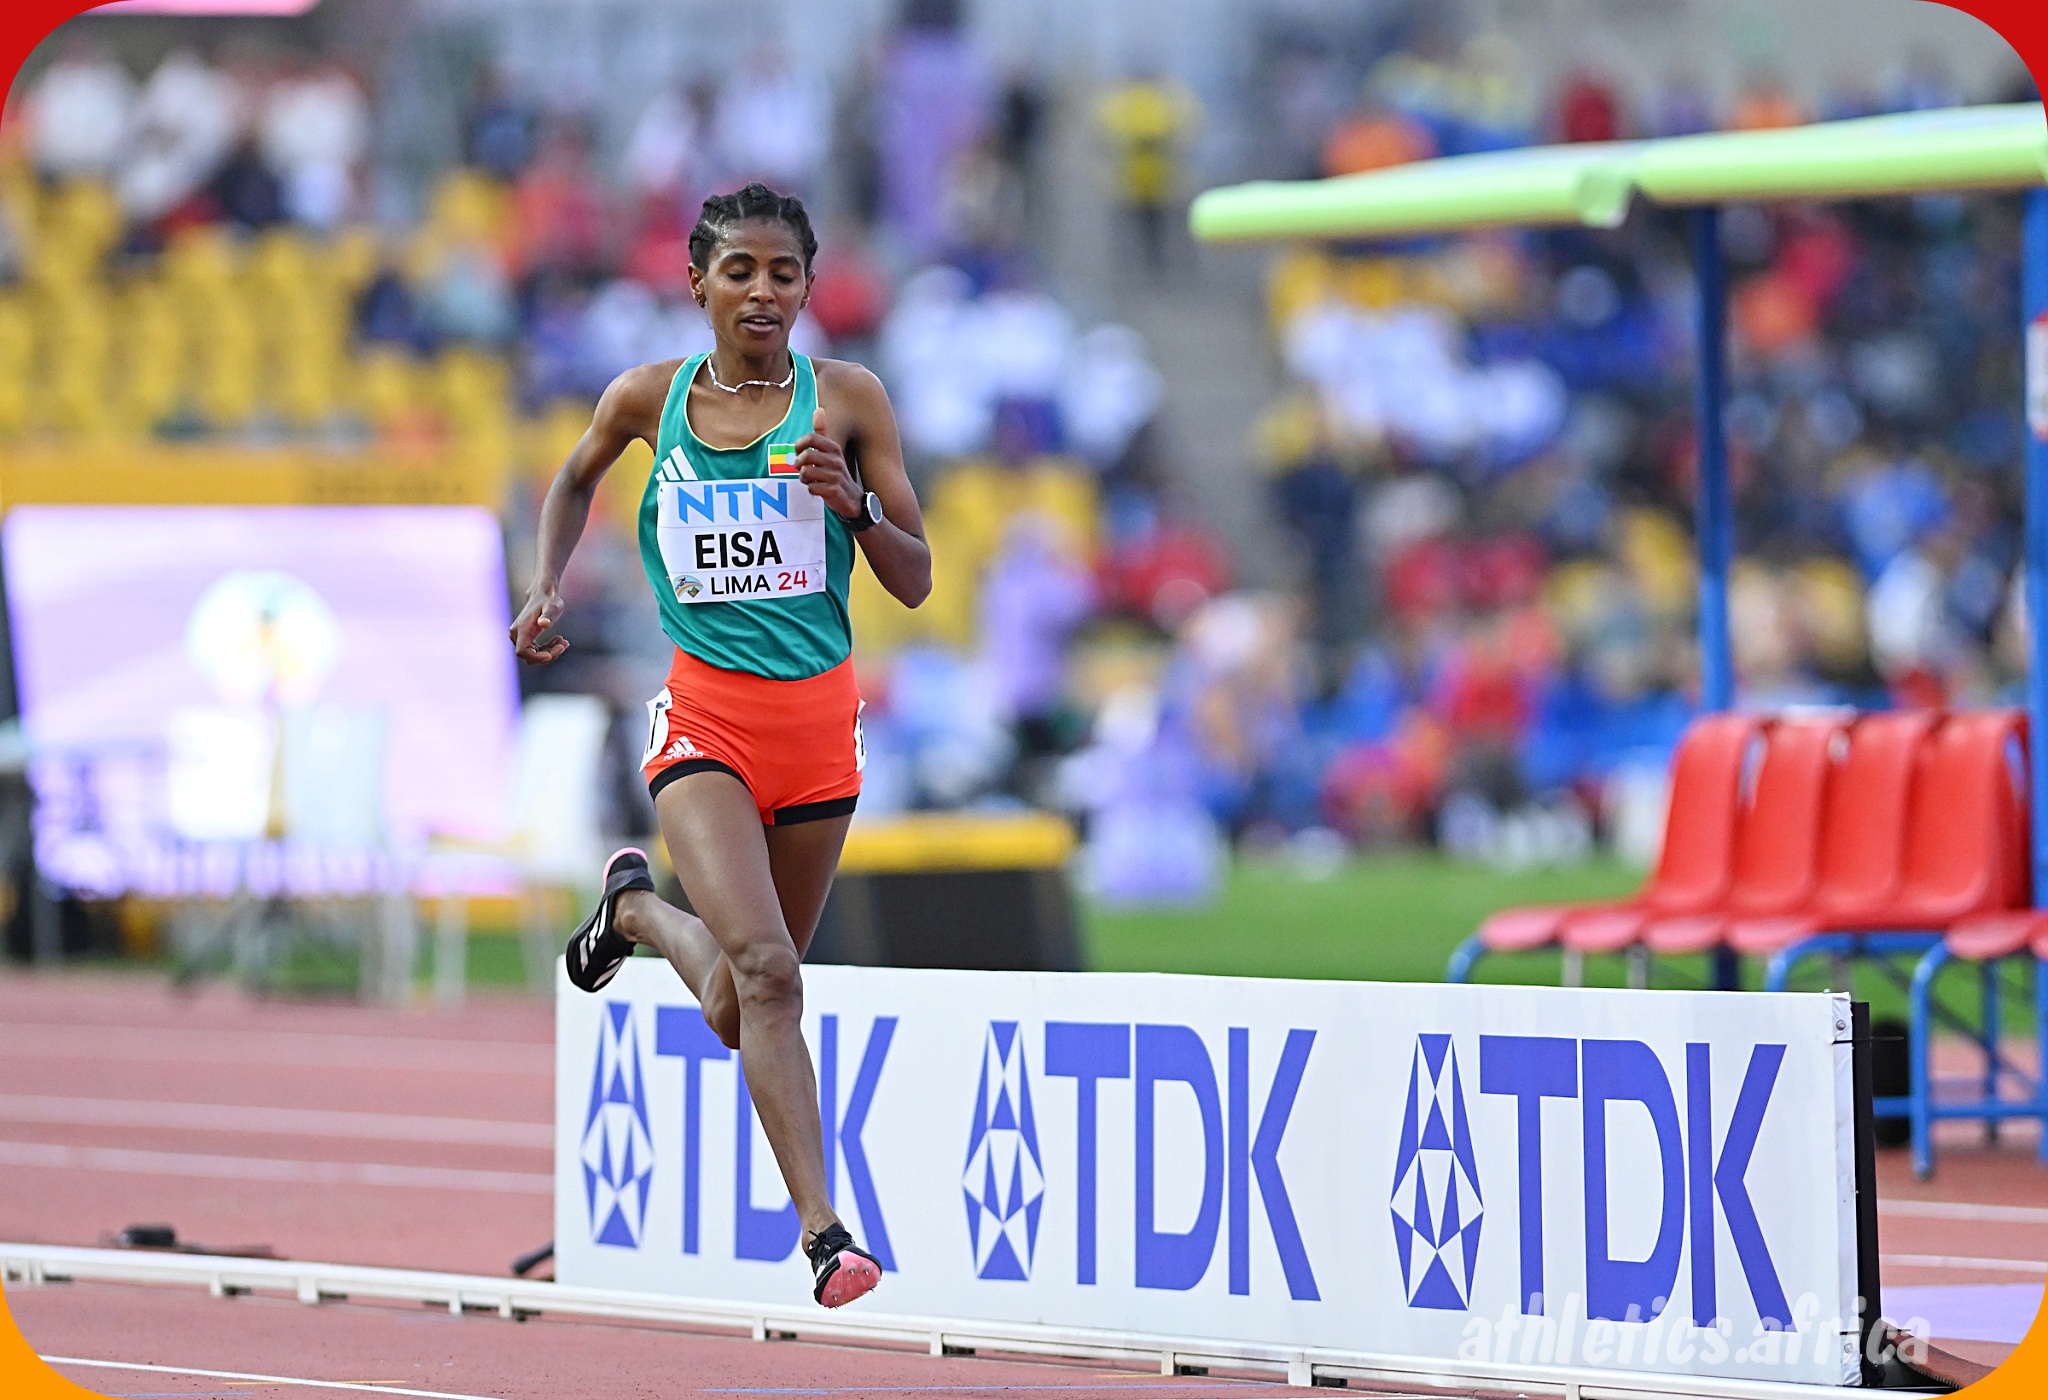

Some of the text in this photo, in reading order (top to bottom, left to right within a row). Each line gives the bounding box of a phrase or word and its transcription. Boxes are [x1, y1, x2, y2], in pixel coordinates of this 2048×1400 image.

[677, 482, 788, 525] NTN
[694, 530, 783, 570] EISA
[711, 570, 808, 595] LIMA 24
[1045, 1021, 1321, 1302] TDK
[1479, 1034, 1798, 1333] TDK
